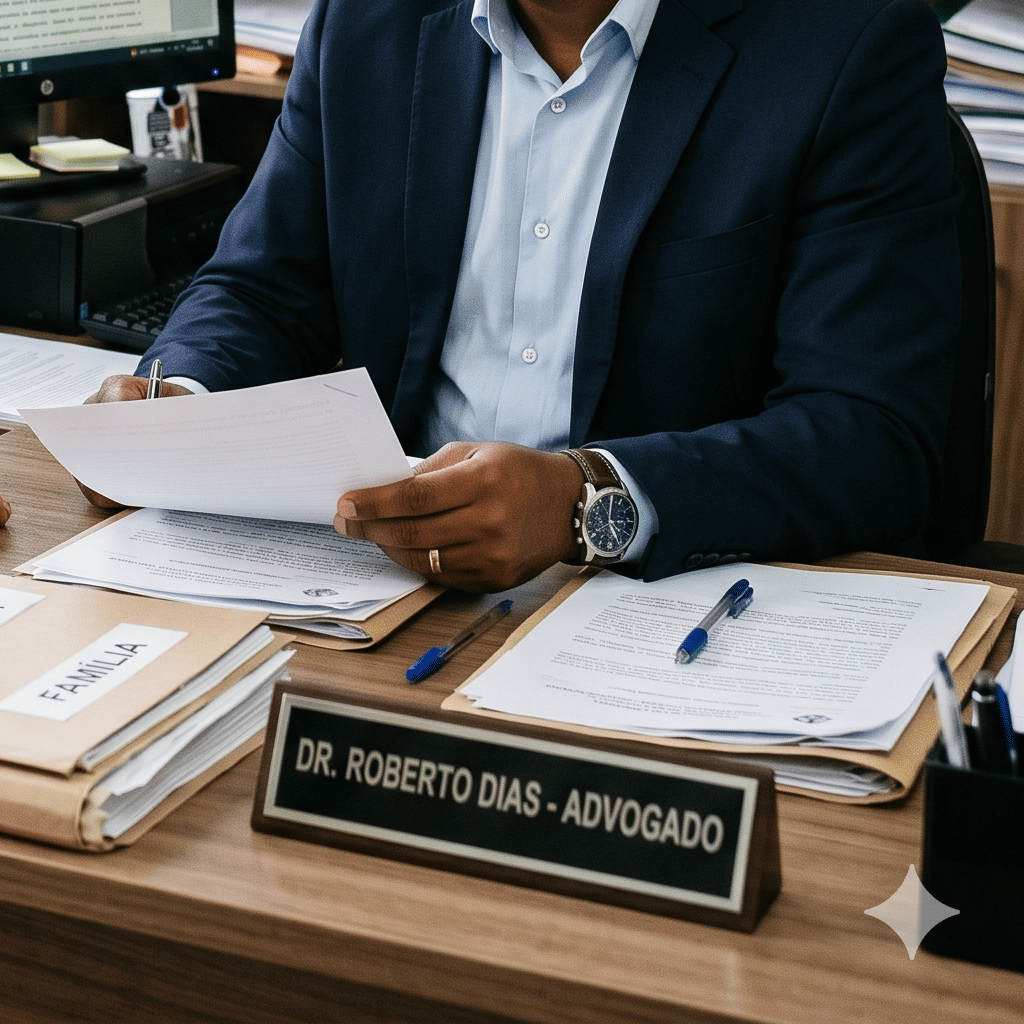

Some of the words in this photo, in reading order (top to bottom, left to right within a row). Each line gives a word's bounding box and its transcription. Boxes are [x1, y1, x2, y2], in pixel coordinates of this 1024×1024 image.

[295, 737, 337, 778] DR.
[345, 747, 473, 804] ROBERTO
[478, 772, 542, 818] DIAS
[561, 788, 725, 854] ADVOGADO
